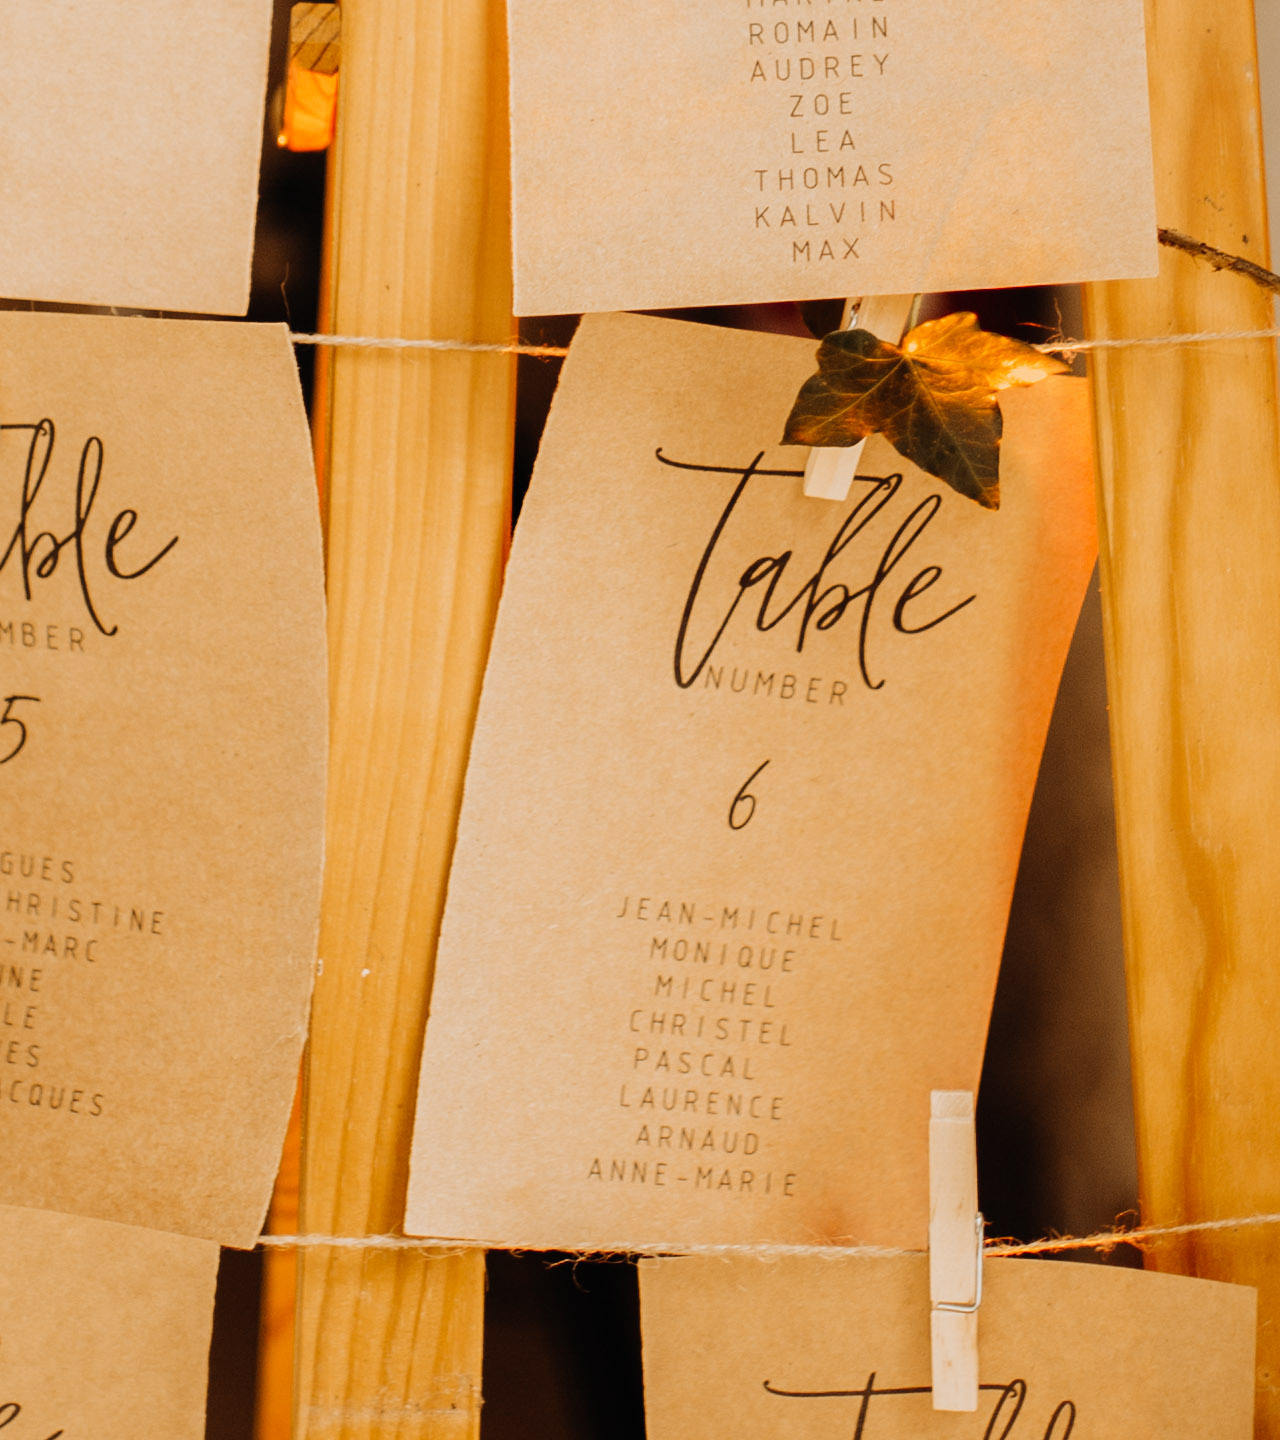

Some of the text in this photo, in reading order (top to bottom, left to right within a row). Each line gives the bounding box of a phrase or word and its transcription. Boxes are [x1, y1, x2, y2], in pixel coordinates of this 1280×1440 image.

[749, 16, 888, 45] ROMAIN
[750, 54, 889, 82] AUDREY
[790, 92, 852, 118] ZOE
[791, 129, 856, 154] LEA
[754, 163, 893, 191] THOMAS
[755, 200, 895, 228] KALVIN
[792, 238, 859, 262] MAX
[703, 664, 849, 707] NUMBER
[728, 759, 771, 831] 6
[617, 896, 841, 941] JEAN-MICHEL
[650, 937, 795, 972] MONIQUE
[654, 974, 774, 1008] MICHEL
[630, 1009, 791, 1047] CHRISTEL
[633, 1047, 754, 1081] PASCAL
[620, 1084, 783, 1120] LAURENCE
[635, 1124, 759, 1155] ARNAUD
[587, 1157, 796, 1197] ANNE-MARIE
